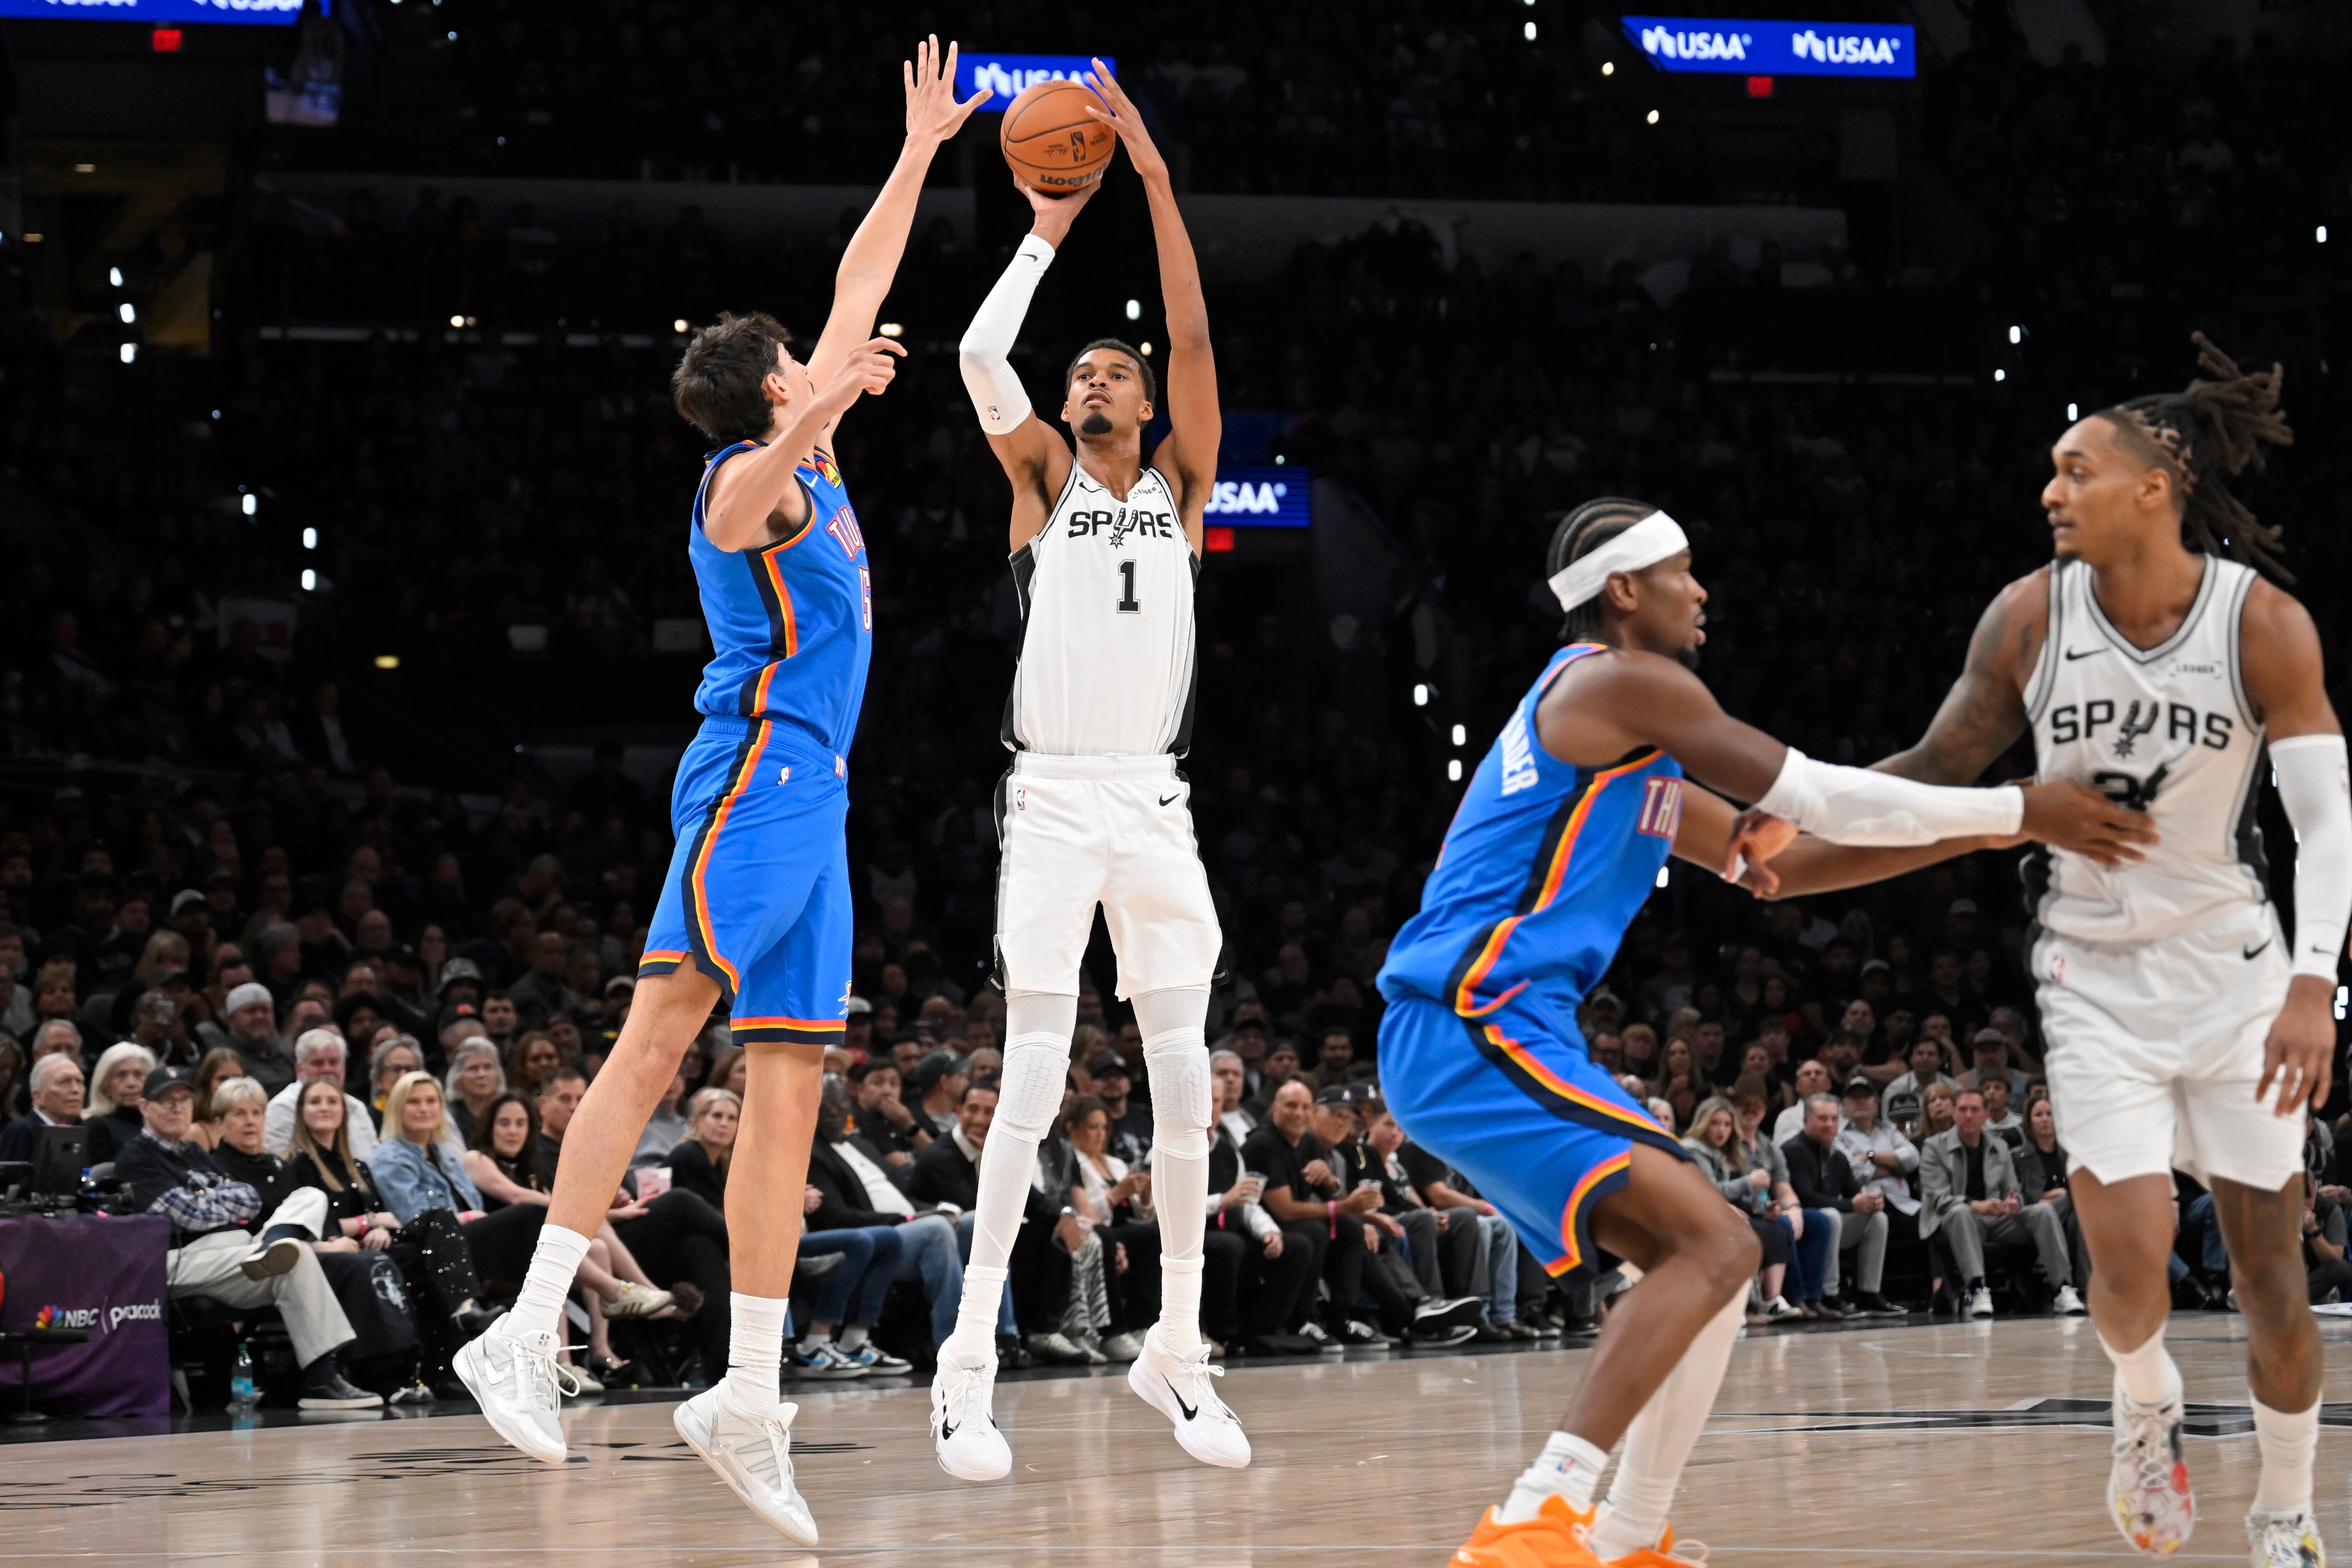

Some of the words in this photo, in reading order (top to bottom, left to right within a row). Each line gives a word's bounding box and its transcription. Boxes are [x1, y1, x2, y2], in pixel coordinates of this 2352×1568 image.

[1068, 508, 1172, 549] SPURS
[1117, 558, 1141, 614] 1
[2051, 699, 2233, 759] SPURS
[64, 1307, 100, 1328] NBC
